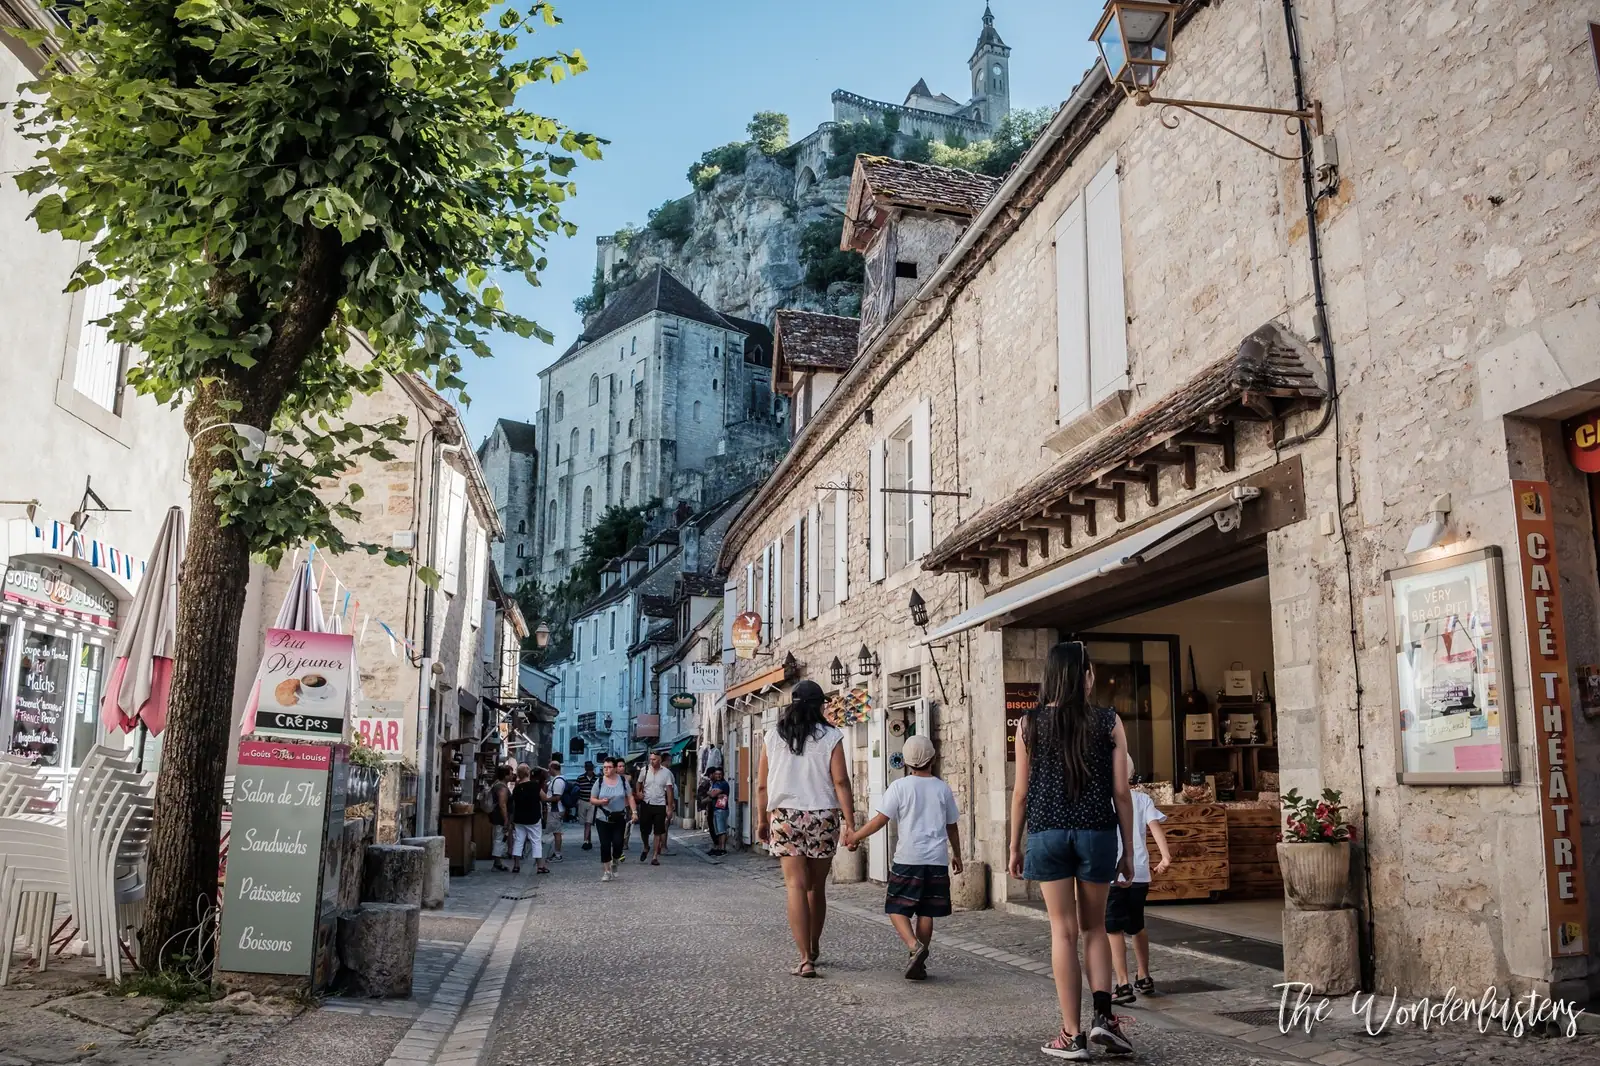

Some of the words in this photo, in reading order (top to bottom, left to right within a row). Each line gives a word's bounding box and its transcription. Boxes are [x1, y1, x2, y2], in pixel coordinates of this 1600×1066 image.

[1575, 419, 1600, 448] C
[1525, 531, 1556, 656] CAFÉ
[1411, 606, 1441, 622] BRAD
[270, 631, 307, 649] Petit
[27, 672, 55, 693] Matchs
[360, 720, 399, 751] BAR
[1007, 718, 1019, 726] CO
[302, 752, 327, 762] Louise
[236, 778, 274, 804] Salon
[277, 780, 292, 805] de
[294, 781, 321, 807] Thé
[1540, 671, 1575, 900] THÉÂTRE
[240, 827, 308, 855] Sandwichs
[238, 876, 302, 904] Pâtisseries
[238, 925, 293, 952] Boissons
